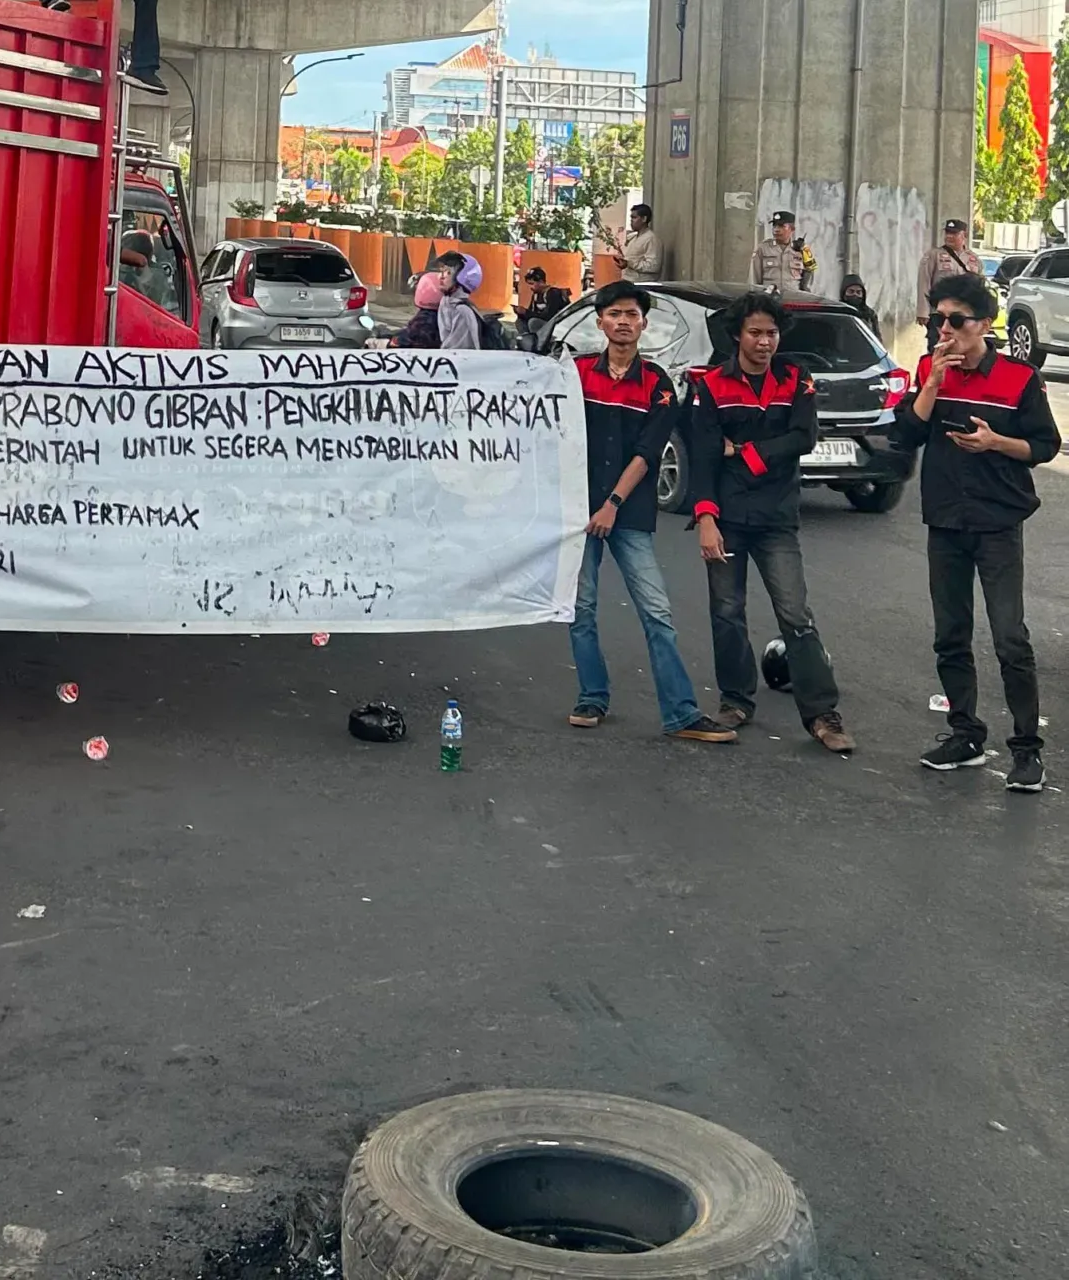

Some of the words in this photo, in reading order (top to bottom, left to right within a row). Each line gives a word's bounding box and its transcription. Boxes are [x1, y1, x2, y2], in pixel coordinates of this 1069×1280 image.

[74, 350, 229, 386] AKTIVIS
[258, 352, 459, 381] MAHASISWA
[145, 391, 248, 430] GIBRAN
[466, 388, 567, 431] RAKYAT
[123, 435, 195, 460] UNTUK
[204, 433, 288, 461] SEGERA
[296, 435, 459, 462] MENSTABILKAN
[468, 437, 520, 463] NILAI
[73, 499, 199, 530] PERTAMAX
